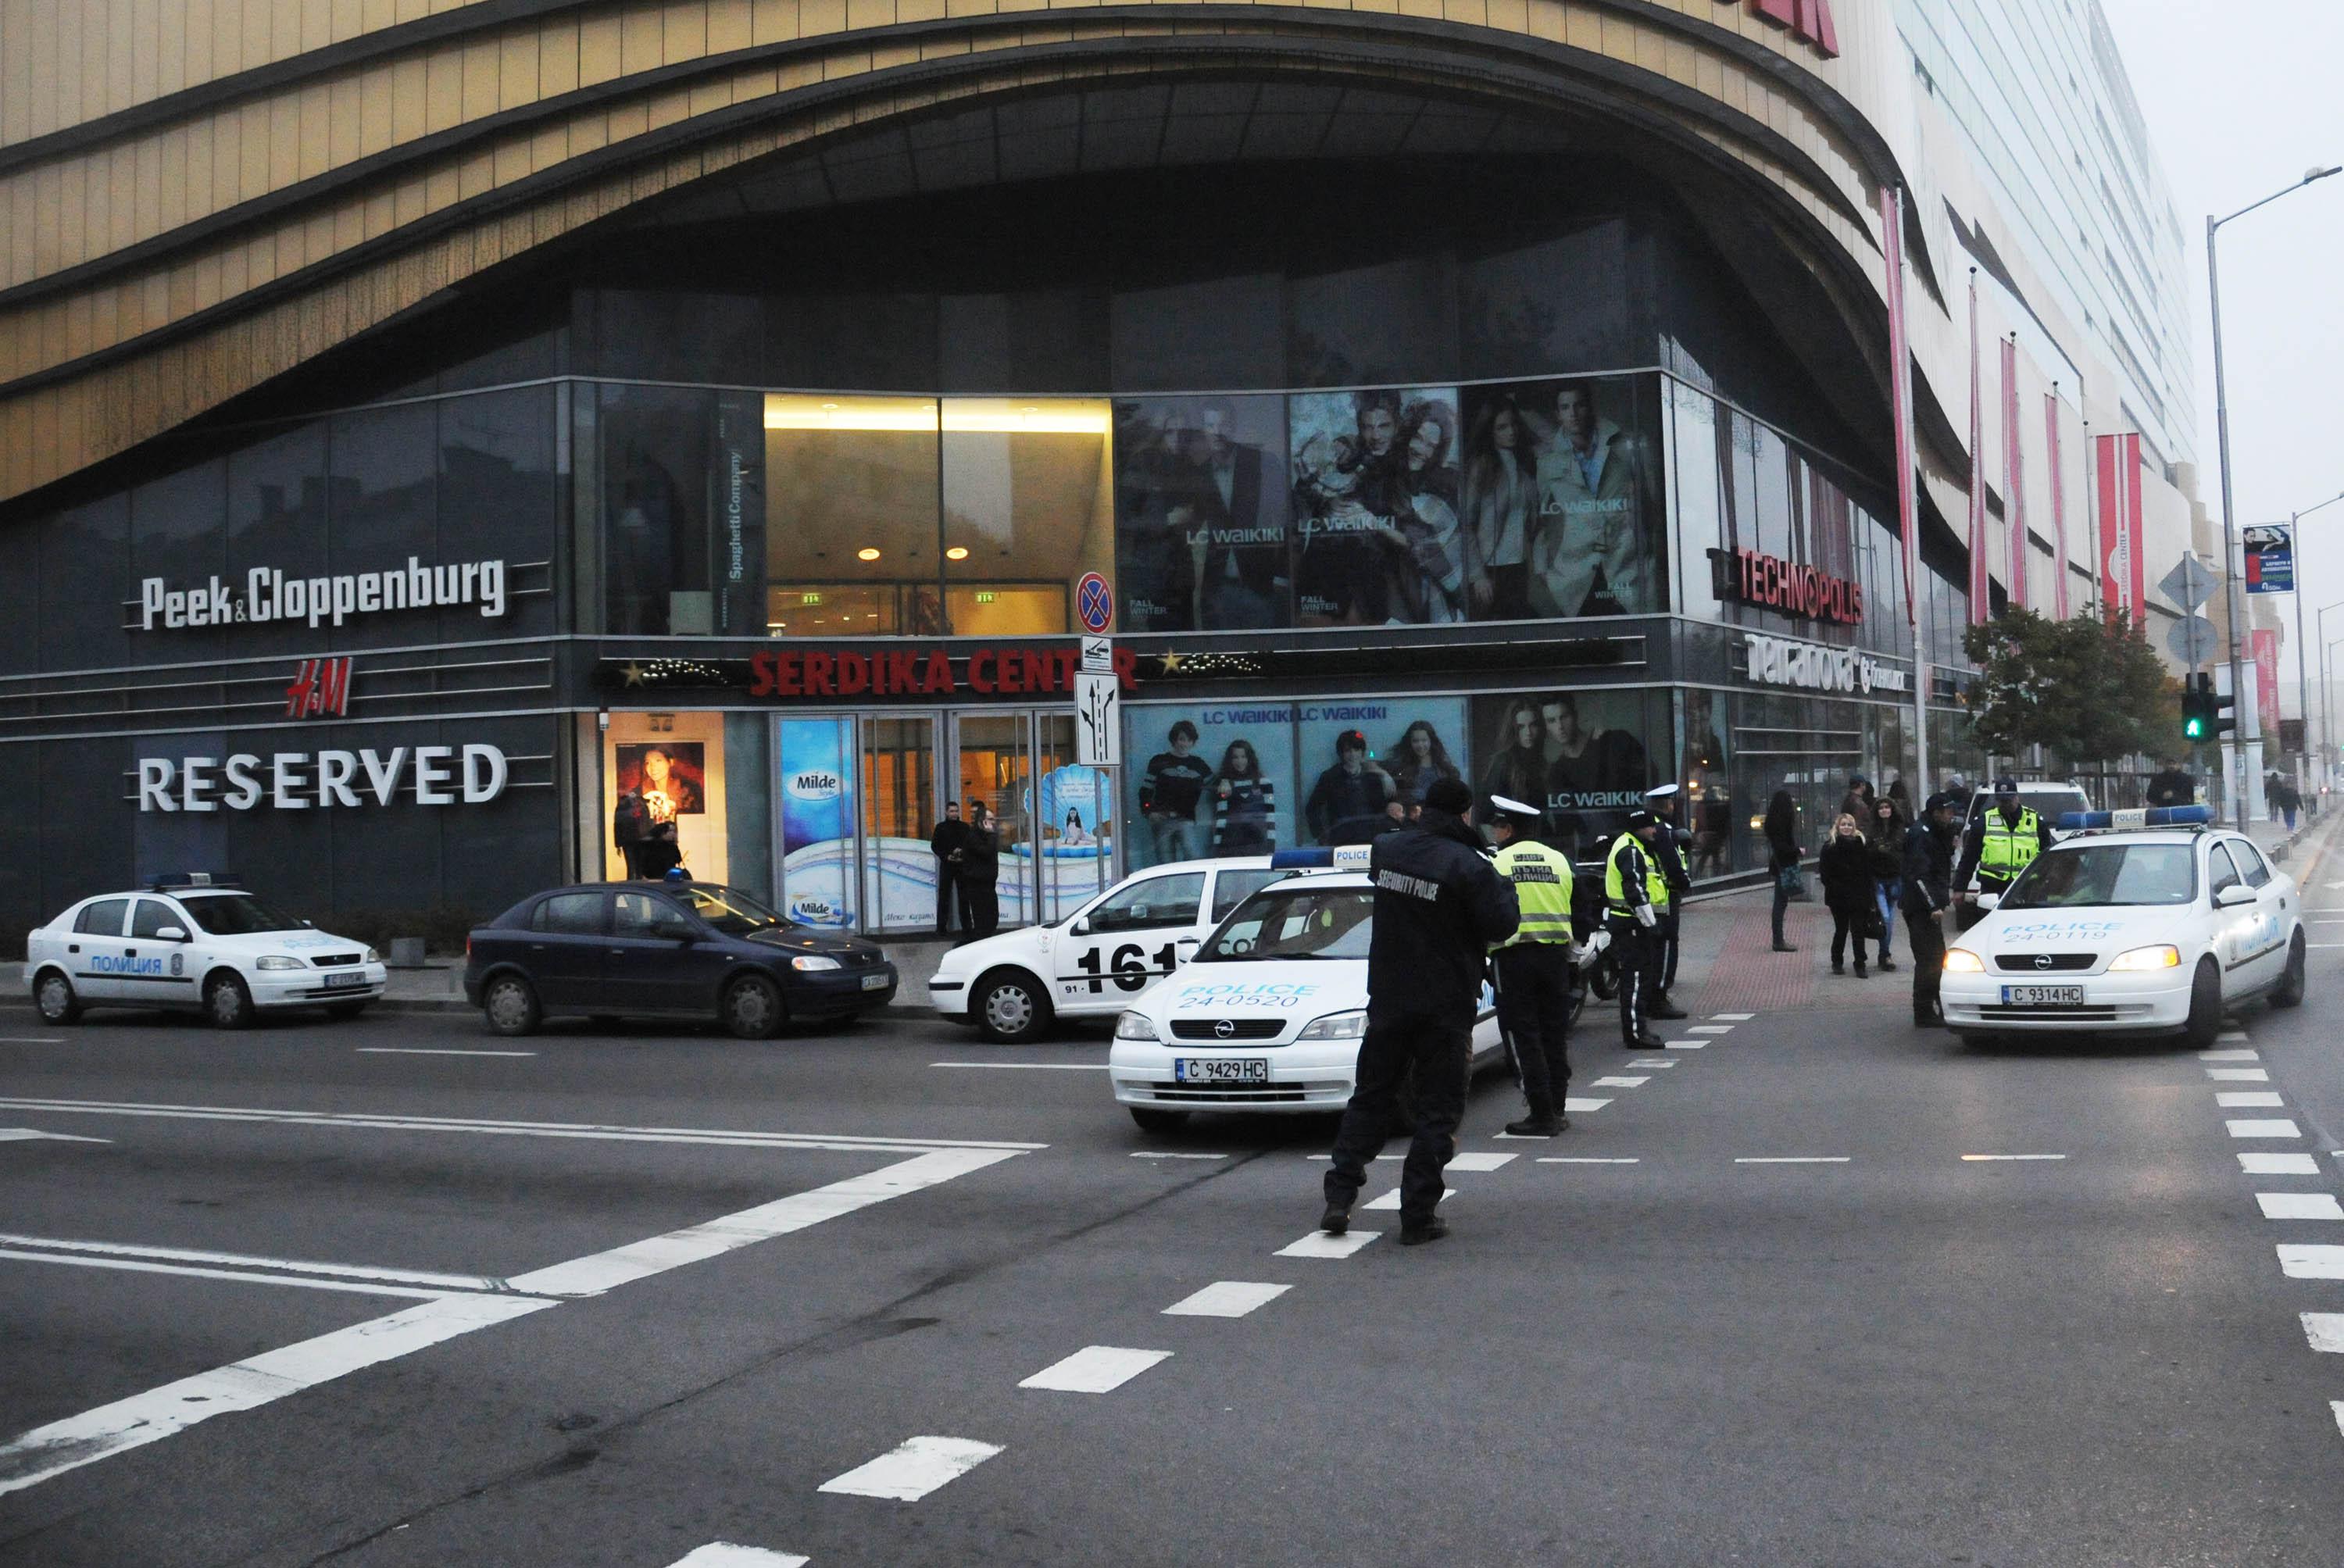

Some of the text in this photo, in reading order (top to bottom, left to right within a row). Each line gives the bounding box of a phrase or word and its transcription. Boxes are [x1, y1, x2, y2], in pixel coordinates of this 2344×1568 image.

[1540, 502, 1561, 514] LC
[728, 452, 743, 579] Spaghetti Company
[1298, 518, 1320, 532] LC
[1186, 531, 1208, 545] LC
[1738, 545, 1863, 623] TECHNOPOLIS
[142, 577, 231, 630] Peek
[248, 556, 505, 627] Cloppenburg
[1130, 606, 1167, 616] WINTER
[1300, 602, 1338, 611] WINTER
[750, 647, 1138, 695] SERDIKA CENTR
[287, 657, 353, 718] H&M
[1203, 710, 1224, 724] LC
[1299, 707, 1319, 721] LC
[139, 744, 509, 811] RESERVED
[797, 775, 836, 789] Milde
[1548, 793, 1571, 808] LC
[2115, 813, 2142, 822] POLICE
[1337, 851, 1368, 860] POLICE
[1377, 869, 1439, 902] SECURITY POLICE
[801, 903, 829, 914] Milde
[2003, 922, 2125, 934] POLICE
[2005, 931, 2107, 943] 24-0119
[91, 956, 162, 974] ПОЛИЦИЯ
[1077, 942, 1176, 994] 161
[1180, 984, 1321, 997] POLICE
[2014, 988, 2079, 1001] C 9314 HC
[1177, 995, 1299, 1009] 24-0520
[1190, 1062, 1263, 1078] C 9429 HC
